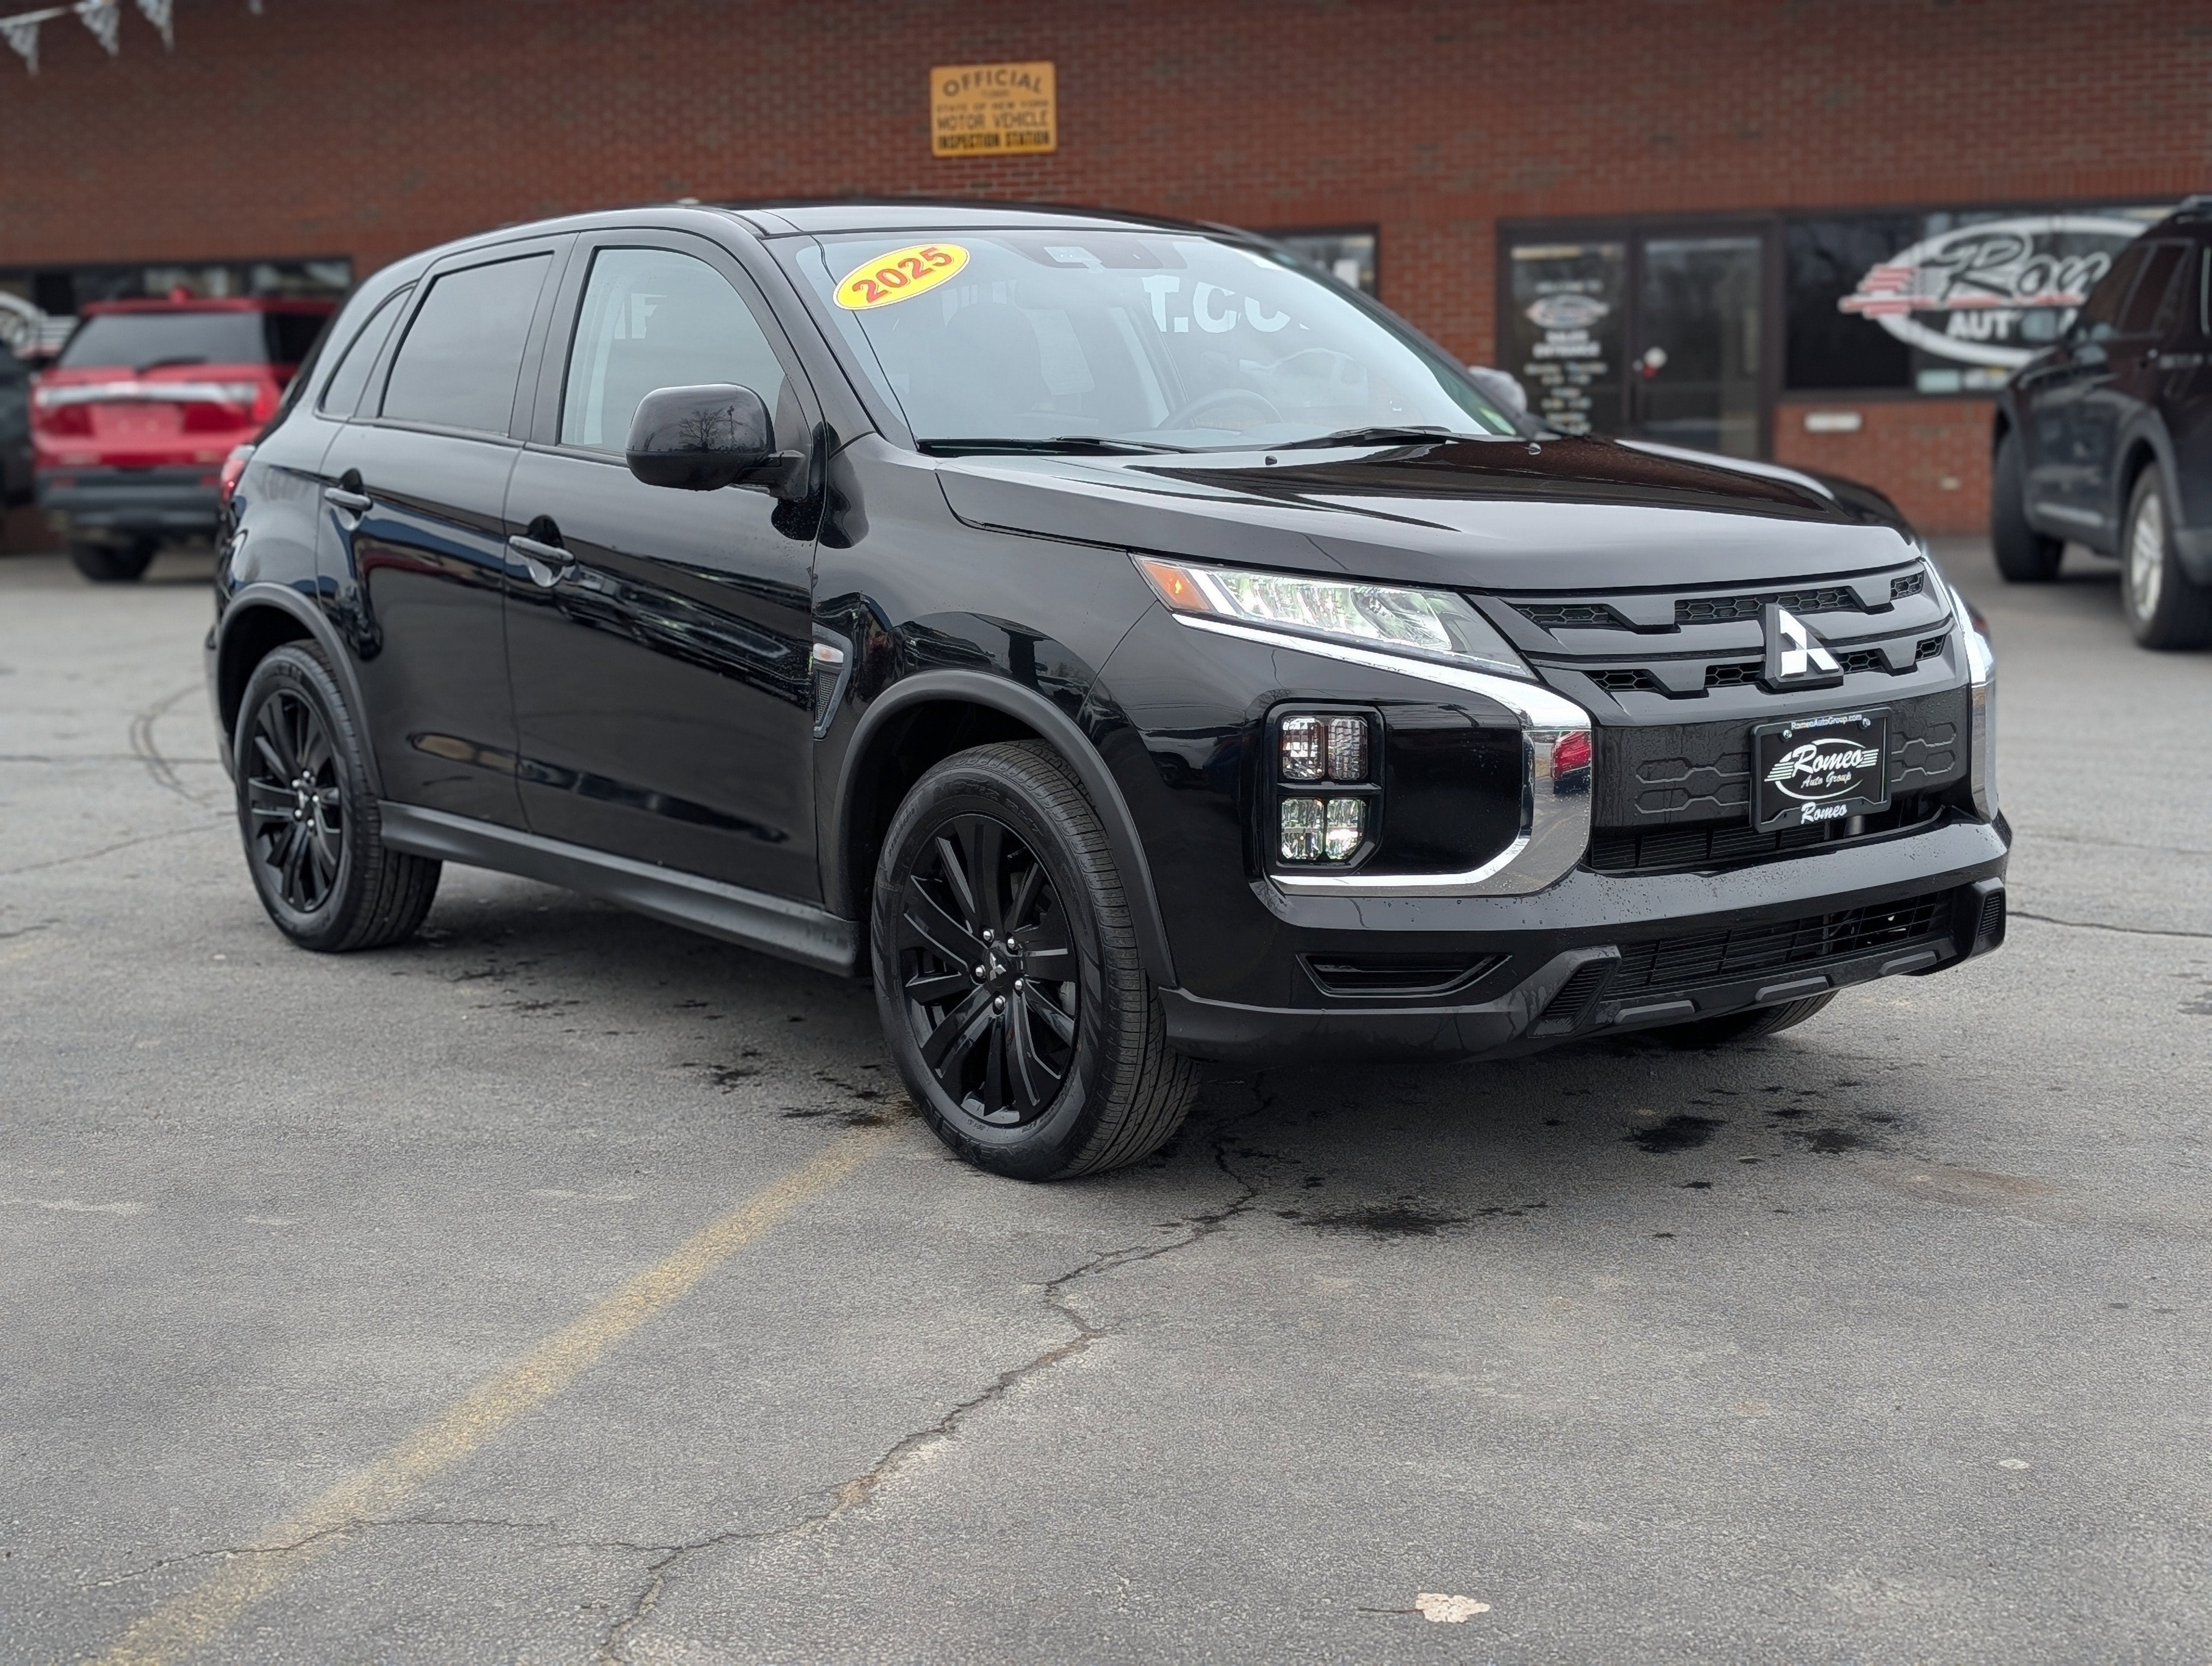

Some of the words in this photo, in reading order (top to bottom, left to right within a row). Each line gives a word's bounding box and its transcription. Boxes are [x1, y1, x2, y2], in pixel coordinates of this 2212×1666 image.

[942, 68, 1042, 96] OFFICIAL
[937, 113, 985, 130] MOTOR
[991, 110, 1048, 128] VEHICLE
[938, 133, 1001, 149] INSPECTION
[1005, 131, 1050, 147] STATION
[852, 247, 952, 303] 2025
[1947, 308, 2025, 340] AUT
[1791, 714, 1862, 731] RomeoAutoGroup.com
[1792, 744, 1864, 777] Romeo
[1801, 774, 1823, 789] Auto
[1826, 771, 1851, 787] Group
[1801, 802, 1848, 825] Romeo
